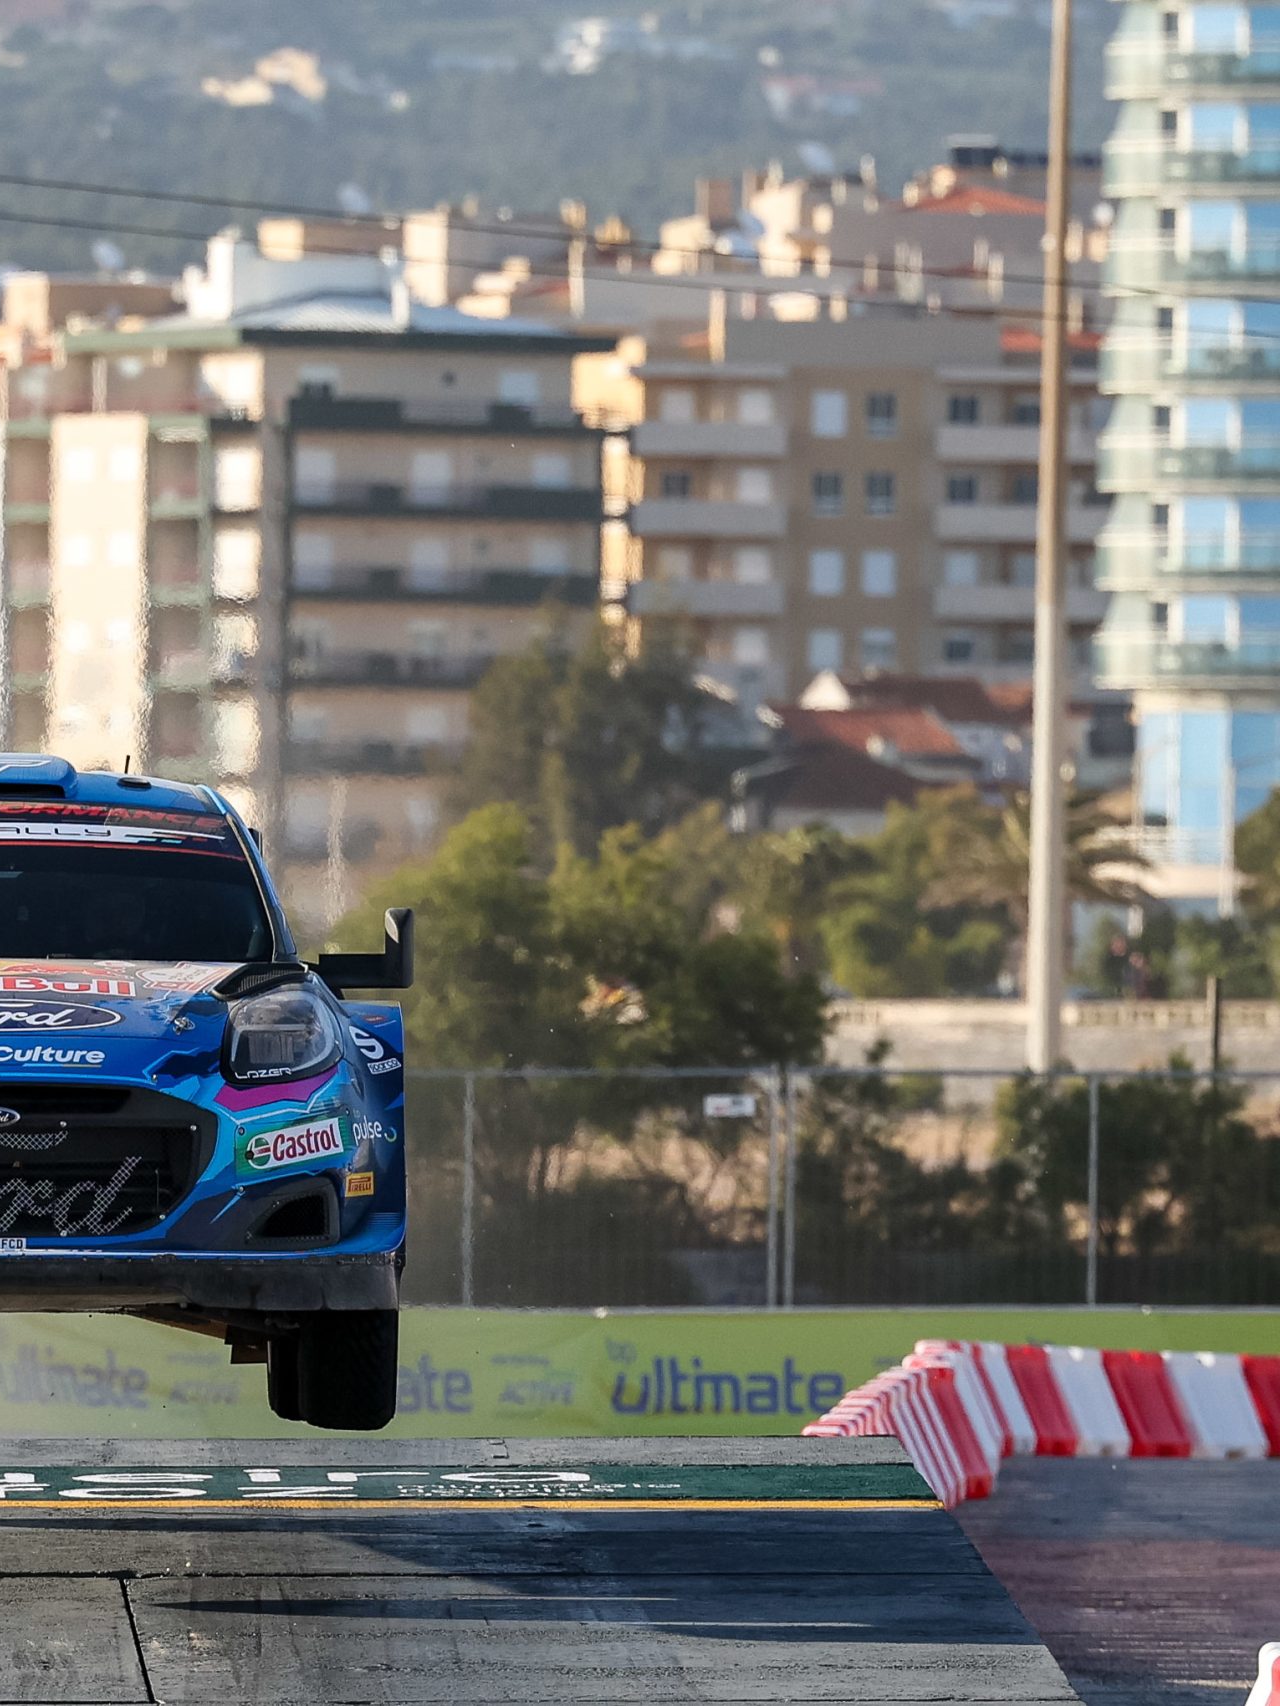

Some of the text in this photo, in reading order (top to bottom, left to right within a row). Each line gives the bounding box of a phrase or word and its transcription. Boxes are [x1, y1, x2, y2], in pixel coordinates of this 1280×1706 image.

[235, 1067, 293, 1079] LAZER
[272, 1123, 340, 1162] Castrol
[352, 1116, 383, 1146] pulse
[348, 1175, 372, 1193] PIRELLI
[1, 1238, 24, 1250] FCD
[611, 1356, 846, 1416] ultimate
